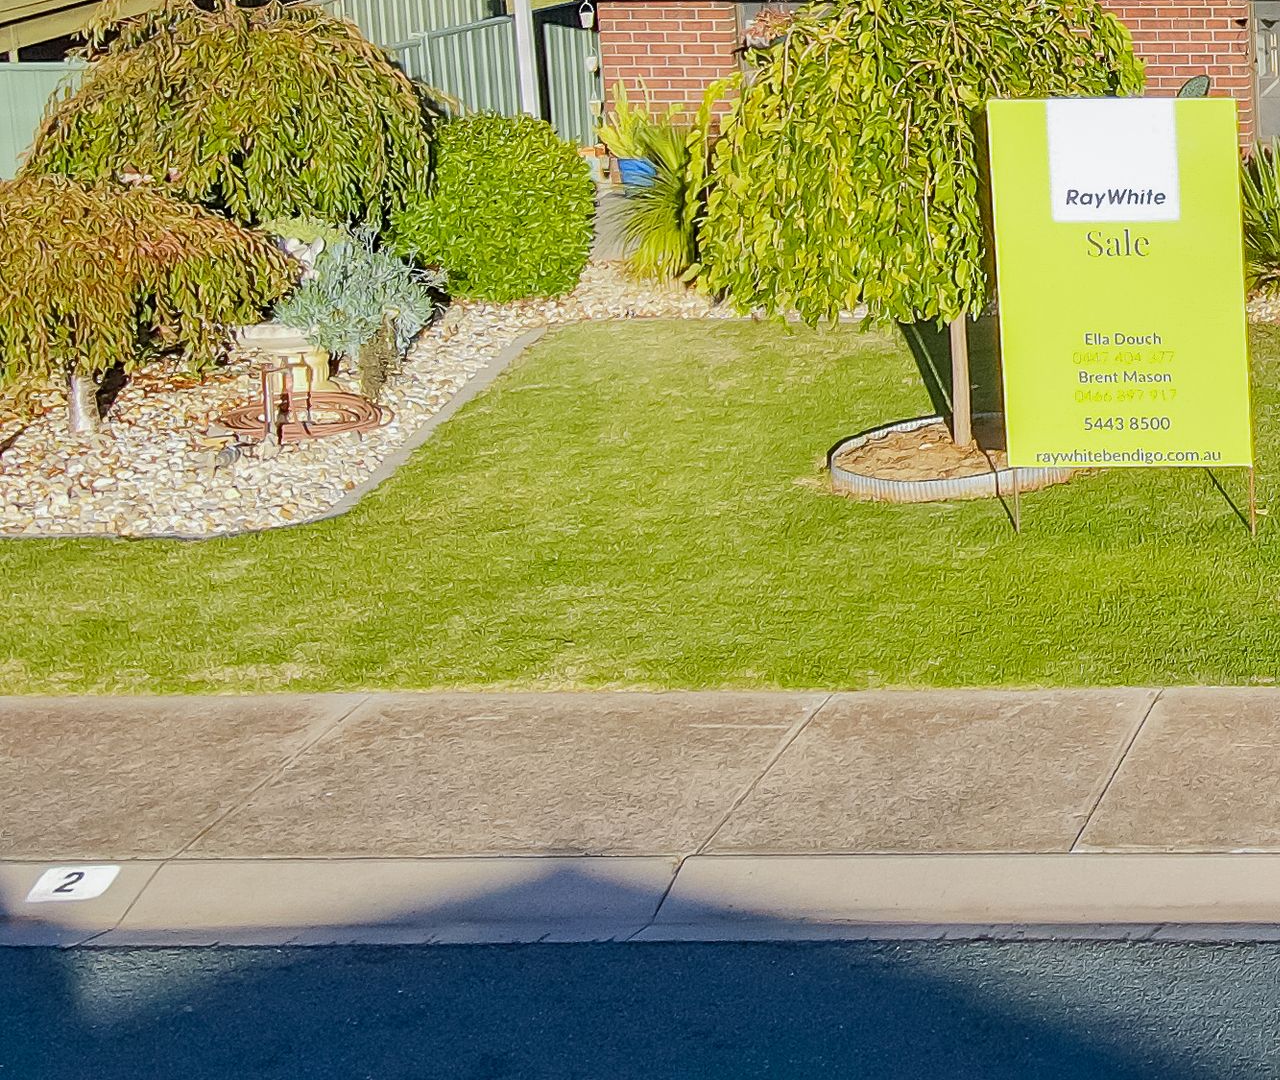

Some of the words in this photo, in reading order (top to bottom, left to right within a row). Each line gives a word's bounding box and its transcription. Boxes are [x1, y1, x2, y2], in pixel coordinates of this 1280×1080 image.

[1086, 228, 1151, 258] Sale
[1084, 332, 1110, 346] Ella
[1114, 332, 1162, 346] Douch
[1078, 370, 1118, 383] Brent
[1123, 370, 1172, 383] Mason
[1084, 417, 1124, 431] 5443
[1129, 417, 1171, 431] 8500
[1036, 448, 1222, 465] raywhitebendigo.com.au
[51, 871, 86, 894] 2
